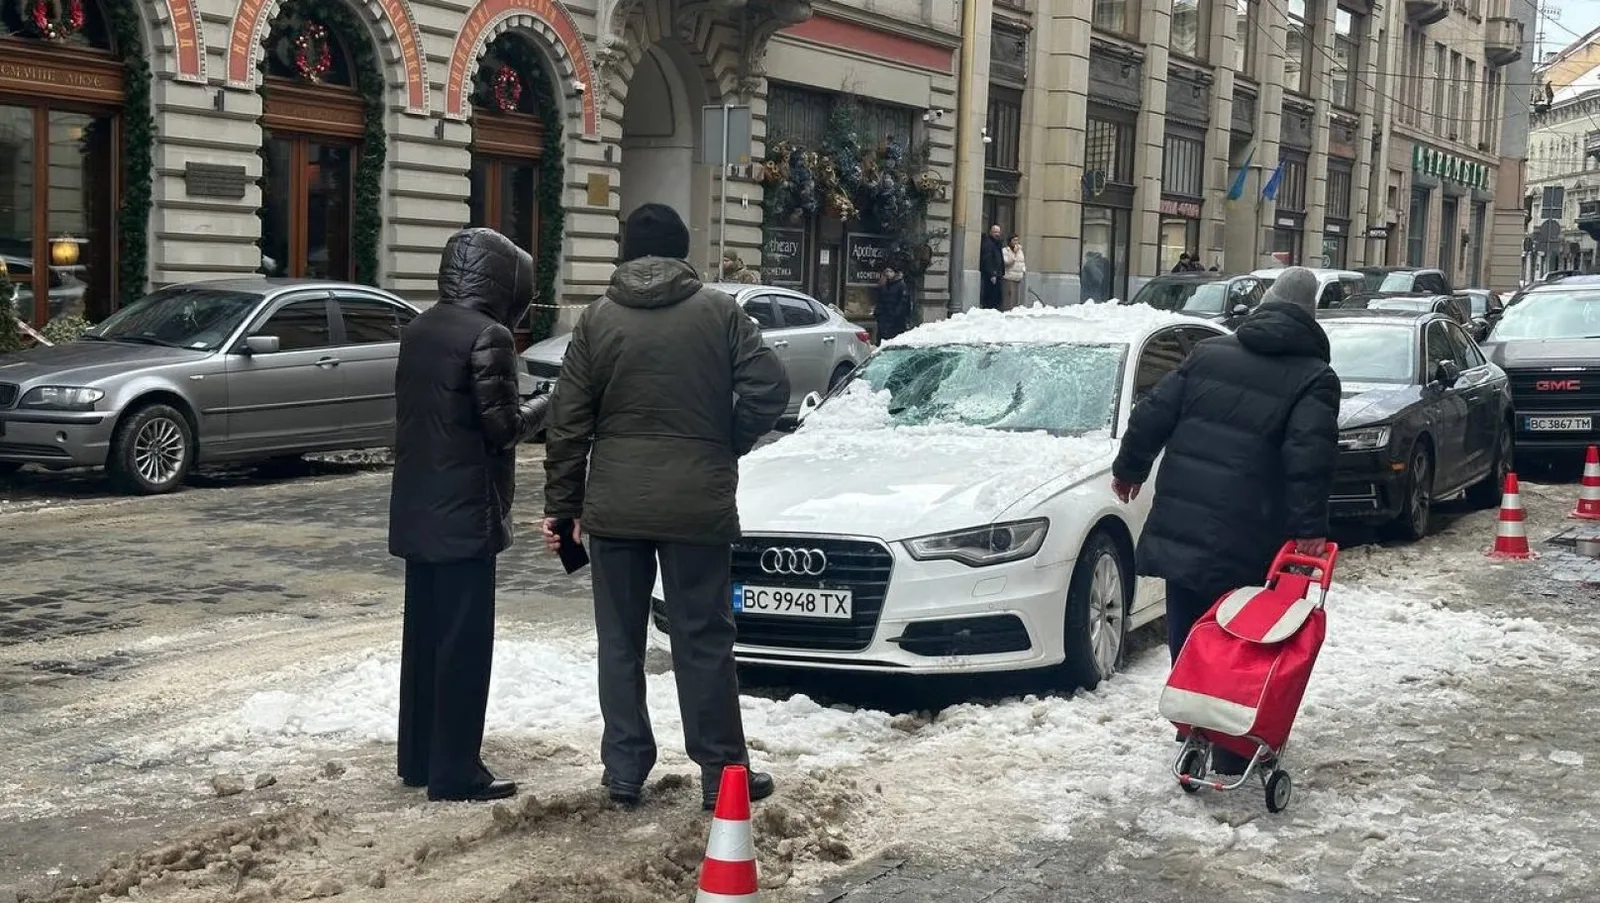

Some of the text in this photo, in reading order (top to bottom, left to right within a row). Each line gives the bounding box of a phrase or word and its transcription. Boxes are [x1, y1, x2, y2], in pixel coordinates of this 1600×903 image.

[386, 0, 420, 82] СТОЯНКИ
[1536, 380, 1581, 391] GMC
[1531, 419, 1590, 429] BC 3867 TM
[743, 589, 848, 614] BC 9948 TX
